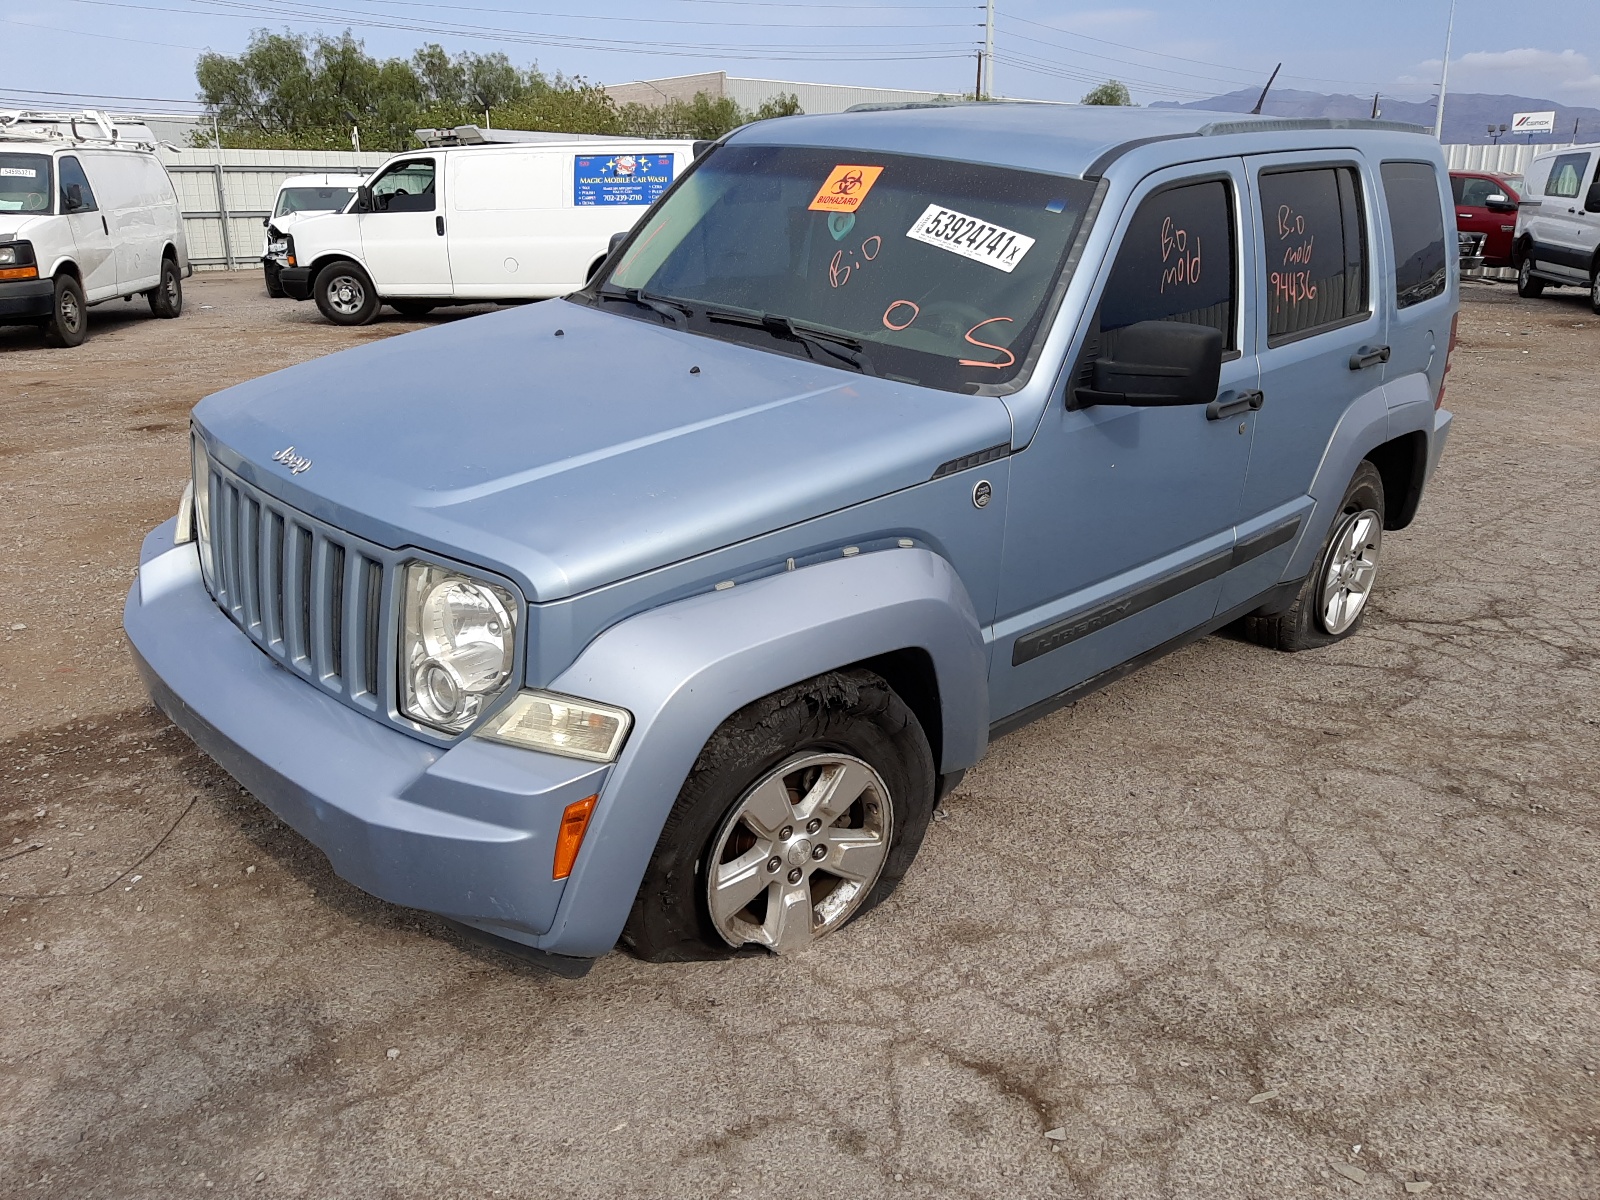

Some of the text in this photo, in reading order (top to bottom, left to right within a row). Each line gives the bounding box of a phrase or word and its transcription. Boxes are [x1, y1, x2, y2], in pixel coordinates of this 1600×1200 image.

[603, 176, 631, 184] MOBILE
[647, 175, 668, 183] WASH
[817, 195, 858, 206] BIOHAZARD
[925, 210, 1016, 259] 53924741
[271, 446, 313, 476] Jeep
[1036, 600, 1132, 653] LIBERTY
